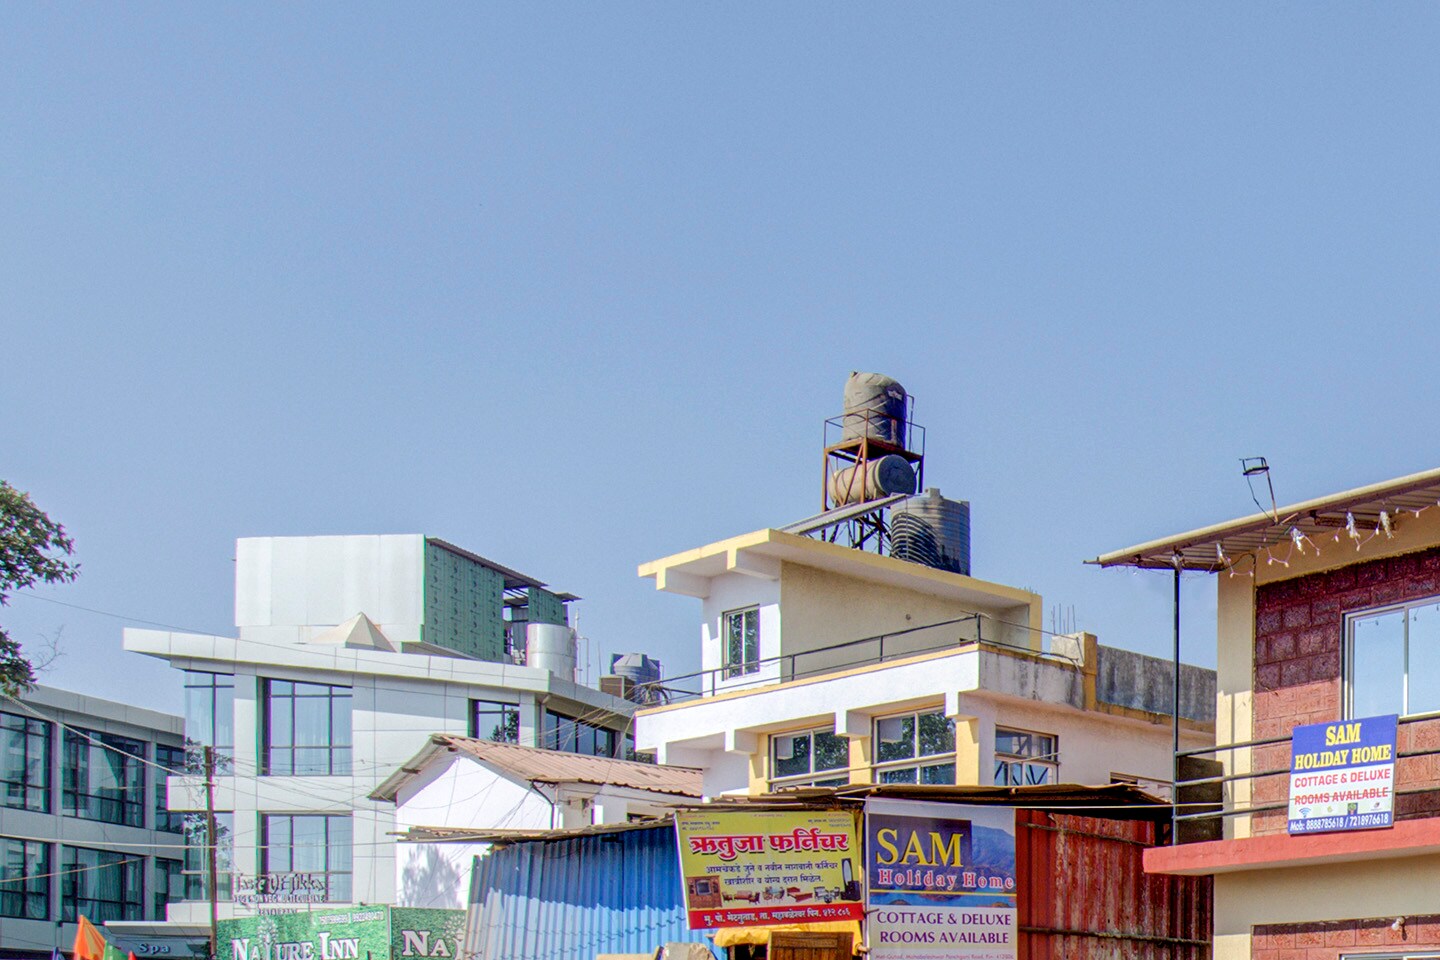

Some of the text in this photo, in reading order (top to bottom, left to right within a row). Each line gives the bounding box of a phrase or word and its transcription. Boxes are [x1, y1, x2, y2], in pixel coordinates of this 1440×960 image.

[1326, 723, 1361, 746] SAM
[1294, 744, 1392, 770] HOLIDAY HOME
[1294, 768, 1391, 788] COTTAGE & DELUXE
[1294, 787, 1389, 805] ROOMS AVAILABLE
[1290, 821, 1305, 831] Mob:
[688, 828, 850, 861] ऋतुजा फर्निचर
[877, 828, 964, 867] SAM
[878, 869, 1014, 890] Holiday Home
[877, 911, 1011, 925] COTTAGE & DELUXE
[318, 931, 360, 960] INN
[880, 931, 1009, 944] ROOMS AVAILABLE
[140, 943, 170, 955] Spa
